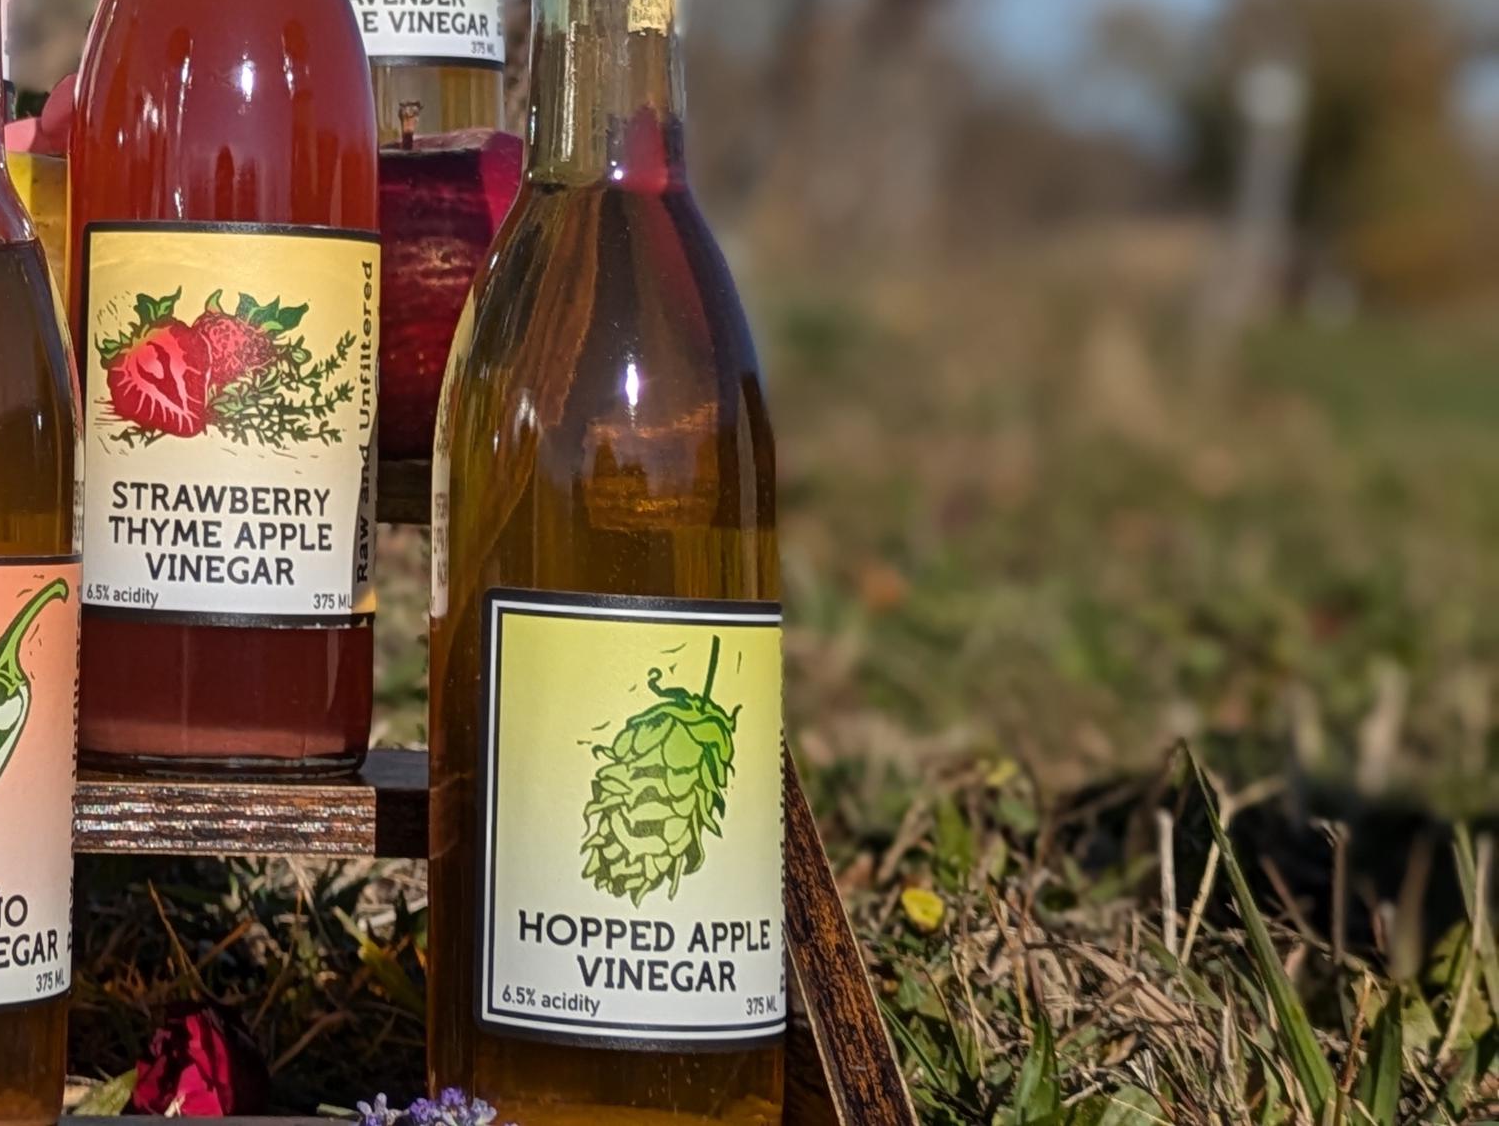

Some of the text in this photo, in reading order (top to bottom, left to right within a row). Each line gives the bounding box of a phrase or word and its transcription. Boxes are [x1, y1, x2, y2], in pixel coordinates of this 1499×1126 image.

[388, 11, 489, 37] VINEGAR
[357, 261, 373, 584] Raw and Unfiltered
[112, 481, 330, 516] STRAWBERRY
[109, 515, 332, 551] THYME APPLE
[145, 552, 295, 585] VINEGAR
[86, 585, 109, 601] 6.5%
[113, 587, 159, 608] acidity
[313, 593, 335, 610] 375
[518, 910, 770, 953] HOPPED APPLE
[35, 970, 53, 993] 375
[577, 954, 736, 993] VINEGAR
[502, 984, 777, 1017] 6.5% acidity 375 ML
